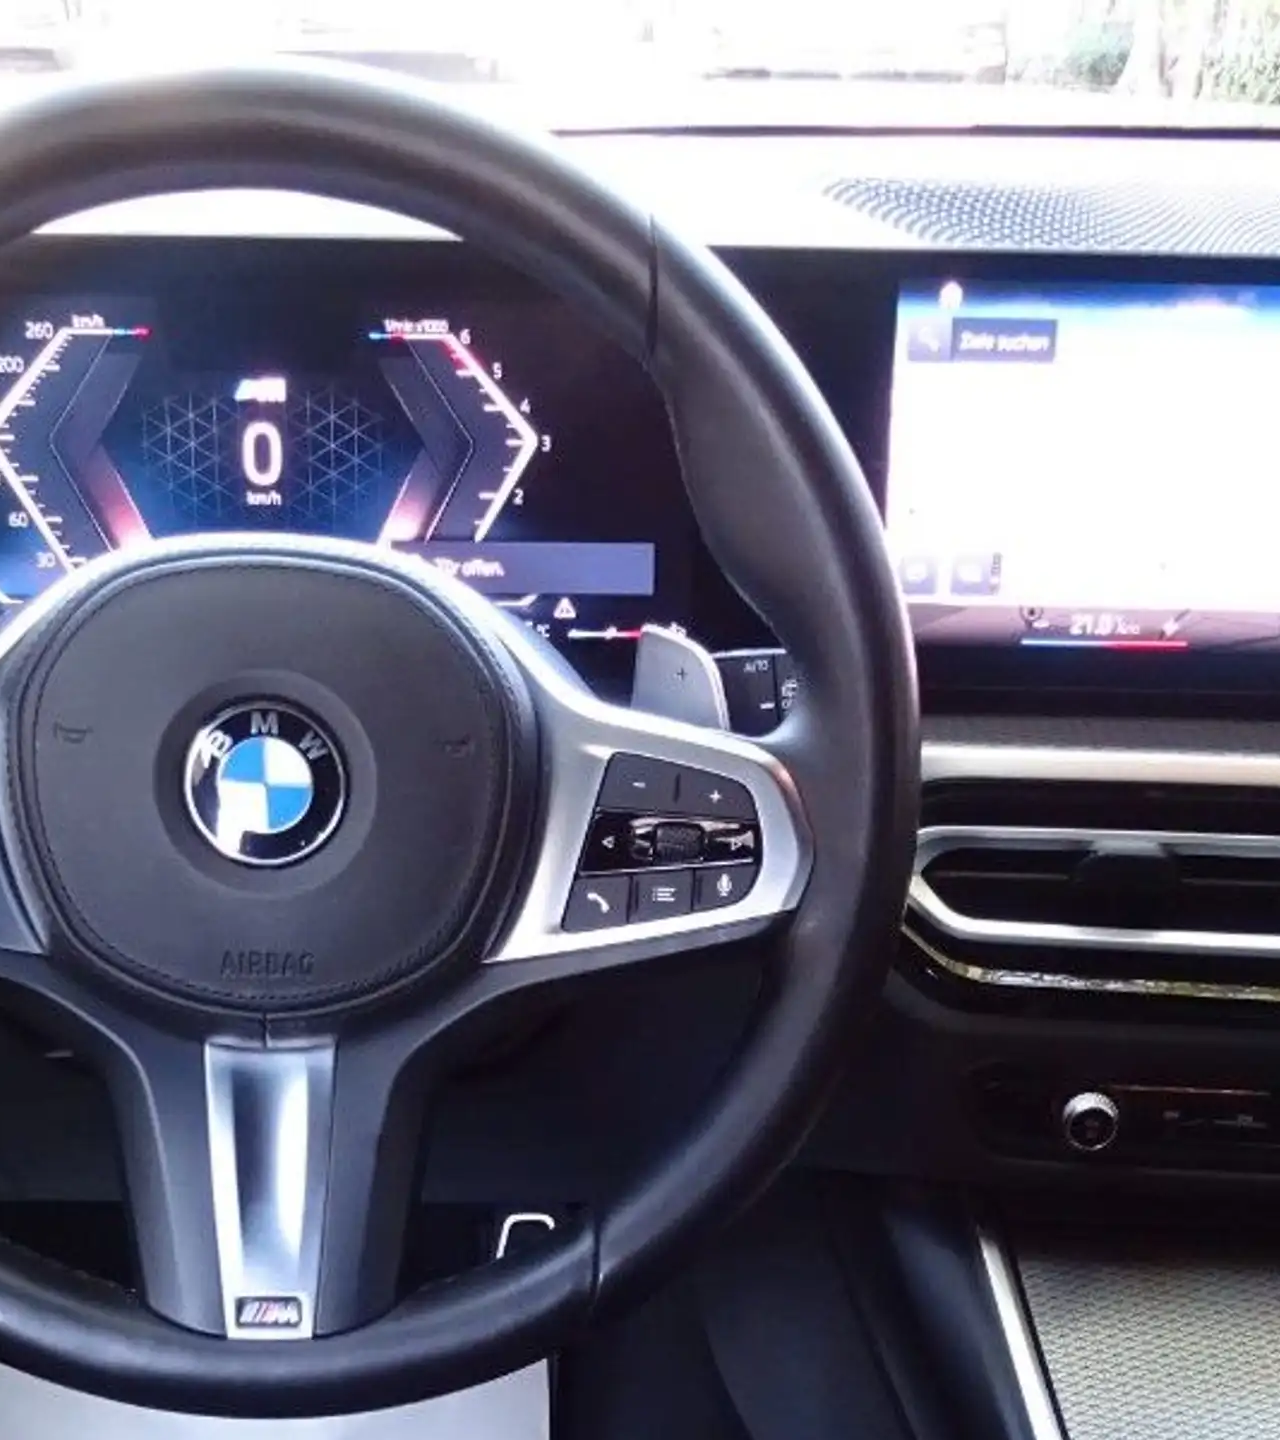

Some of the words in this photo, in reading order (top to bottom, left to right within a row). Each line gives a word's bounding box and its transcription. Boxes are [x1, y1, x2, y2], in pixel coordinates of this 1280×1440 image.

[24, 321, 54, 340] 260
[460, 328, 472, 346] 6
[492, 361, 503, 380] 5
[540, 434, 552, 453] 3
[242, 421, 283, 487] 0
[512, 487, 524, 505] 2
[8, 511, 29, 528] 60
[35, 551, 56, 568] 30
[205, 710, 329, 761] BMW
[220, 949, 316, 977] AIRBAG
